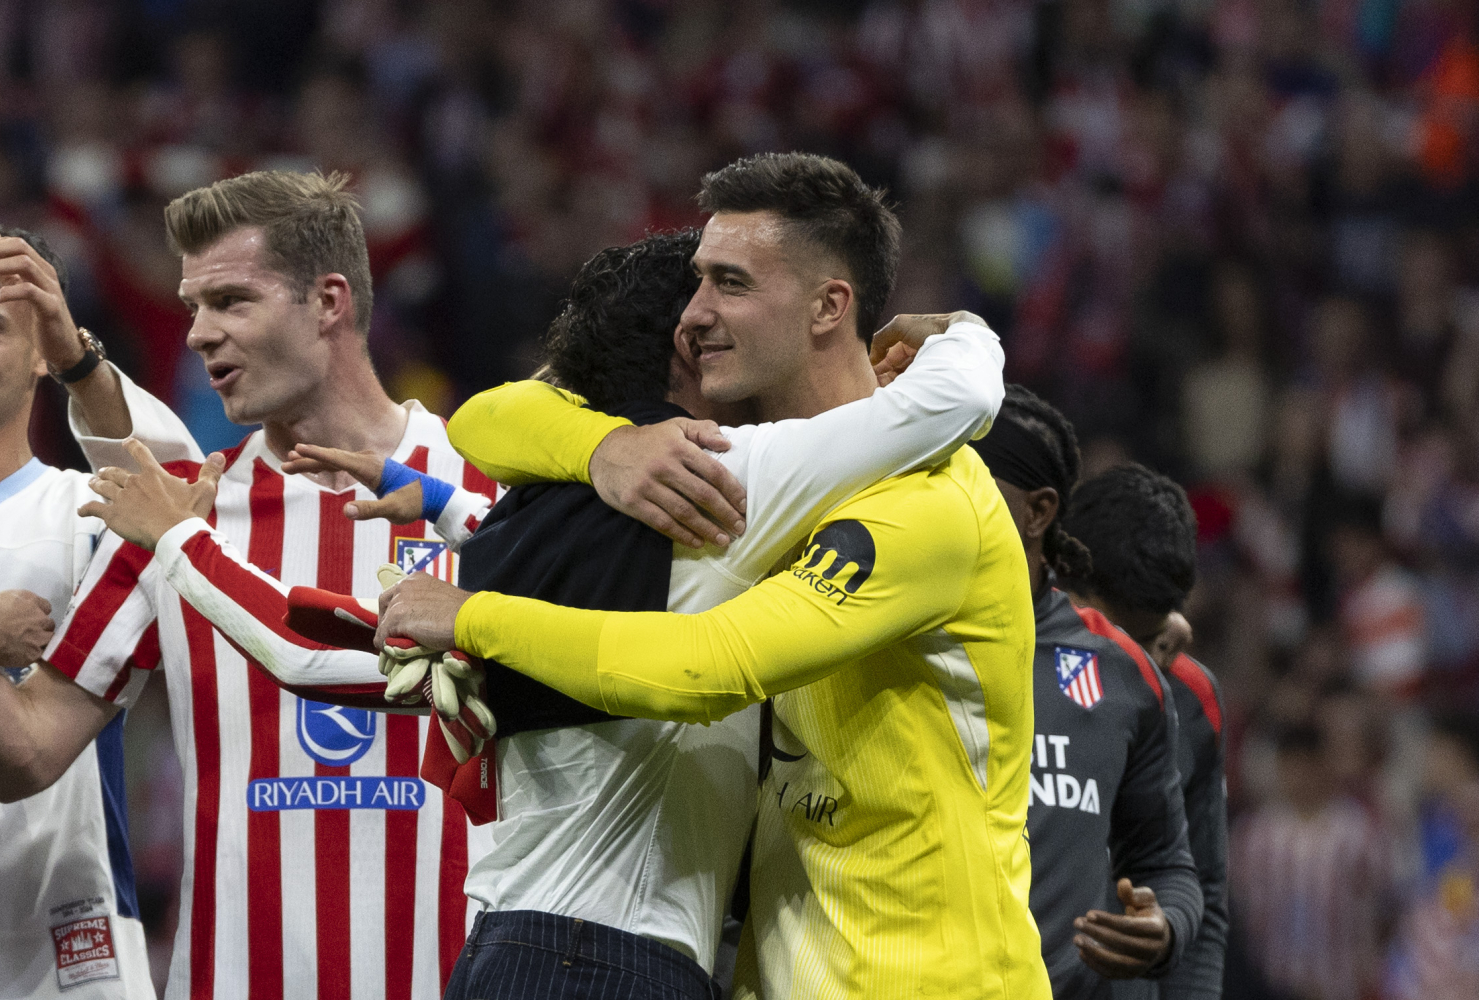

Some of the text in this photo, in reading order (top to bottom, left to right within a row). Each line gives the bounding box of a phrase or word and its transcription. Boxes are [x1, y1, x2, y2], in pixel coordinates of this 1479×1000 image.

[792, 567, 848, 606] aken
[254, 780, 419, 807] RIYADH AIR
[1028, 773, 1101, 815] NDA
[791, 792, 838, 827] AIR
[55, 918, 107, 940] SUPREME
[60, 944, 110, 965] CLASSICS
